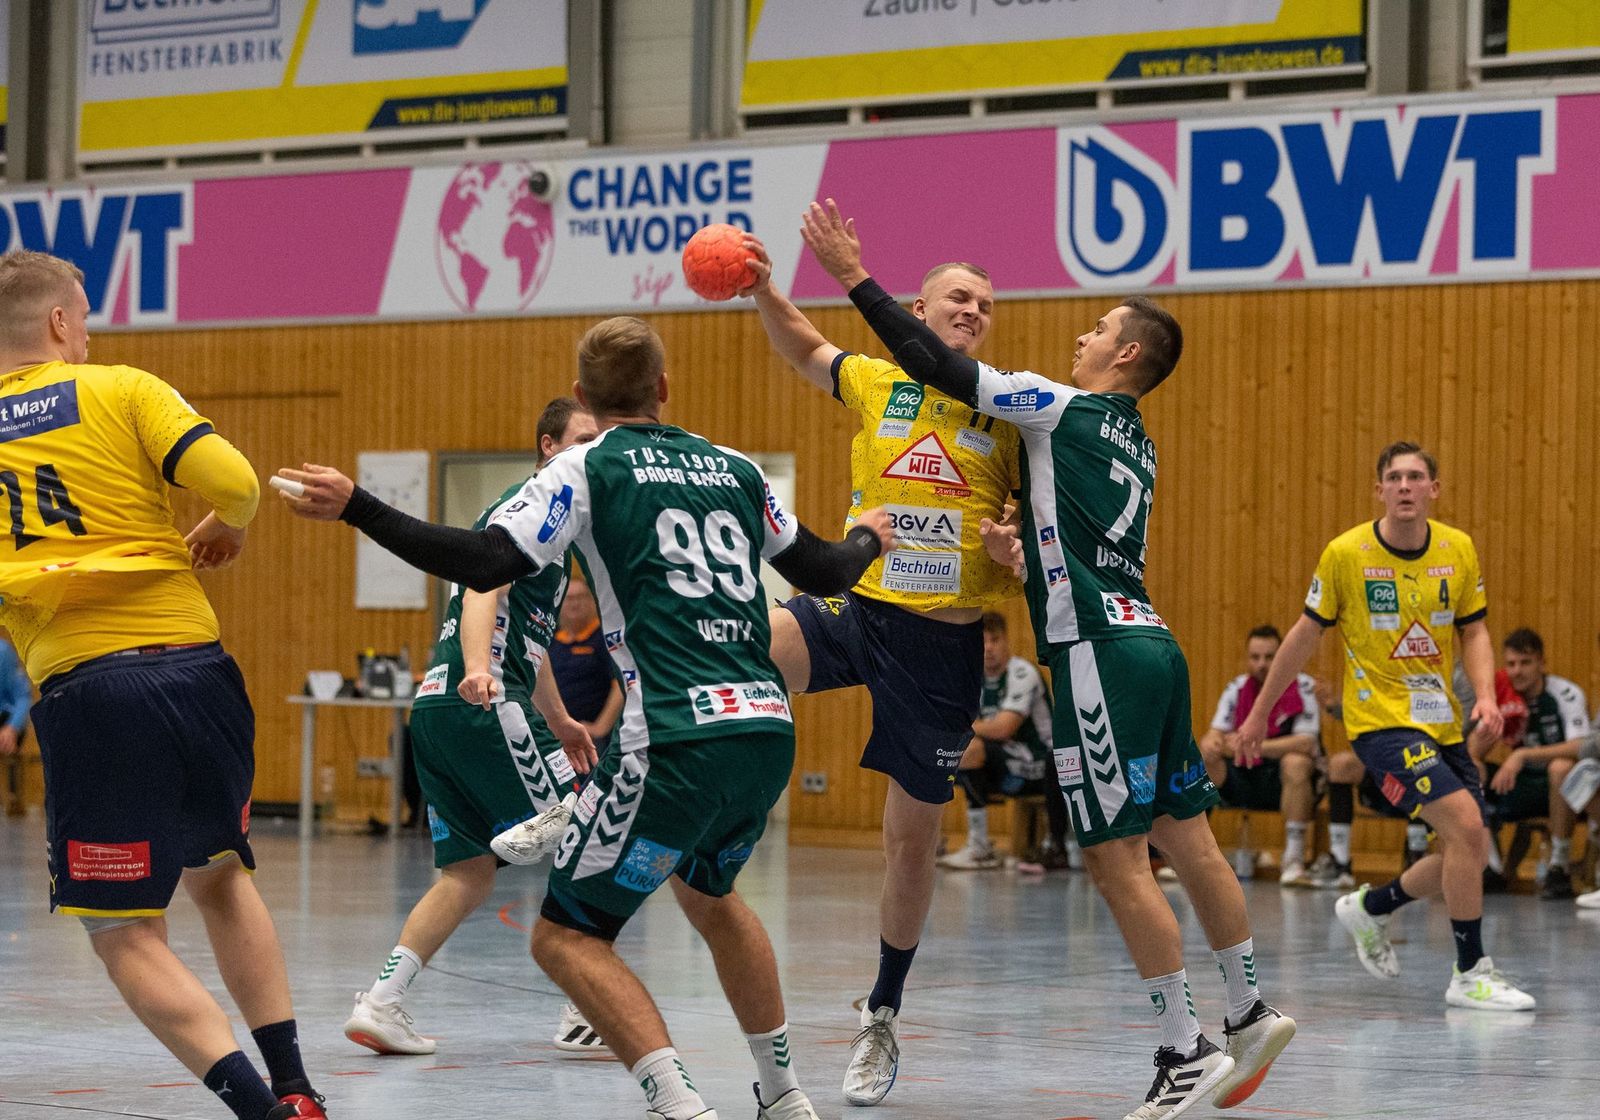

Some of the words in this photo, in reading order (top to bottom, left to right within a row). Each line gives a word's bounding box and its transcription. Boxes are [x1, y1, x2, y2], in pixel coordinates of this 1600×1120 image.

[92, 39, 282, 75] FENSTERFABRIK
[569, 159, 753, 211] CHANGE
[1190, 110, 1541, 271] BWT
[569, 219, 599, 236] THE
[0, 192, 183, 313] WT
[13, 394, 60, 418] Mayr
[1010, 393, 1038, 405] EBB
[886, 405, 916, 417] Bank
[908, 452, 942, 475] WTG
[546, 500, 565, 529] EBB
[655, 508, 757, 602] 99
[891, 558, 951, 576] Bechtold
[1364, 568, 1394, 578] REWE
[1427, 566, 1454, 576] REWE
[885, 579, 954, 591] FENSTERFABRIK
[1439, 579, 1449, 609] 4
[1370, 601, 1396, 611] Bank
[1065, 757, 1075, 767] 72
[554, 823, 581, 869] 9
